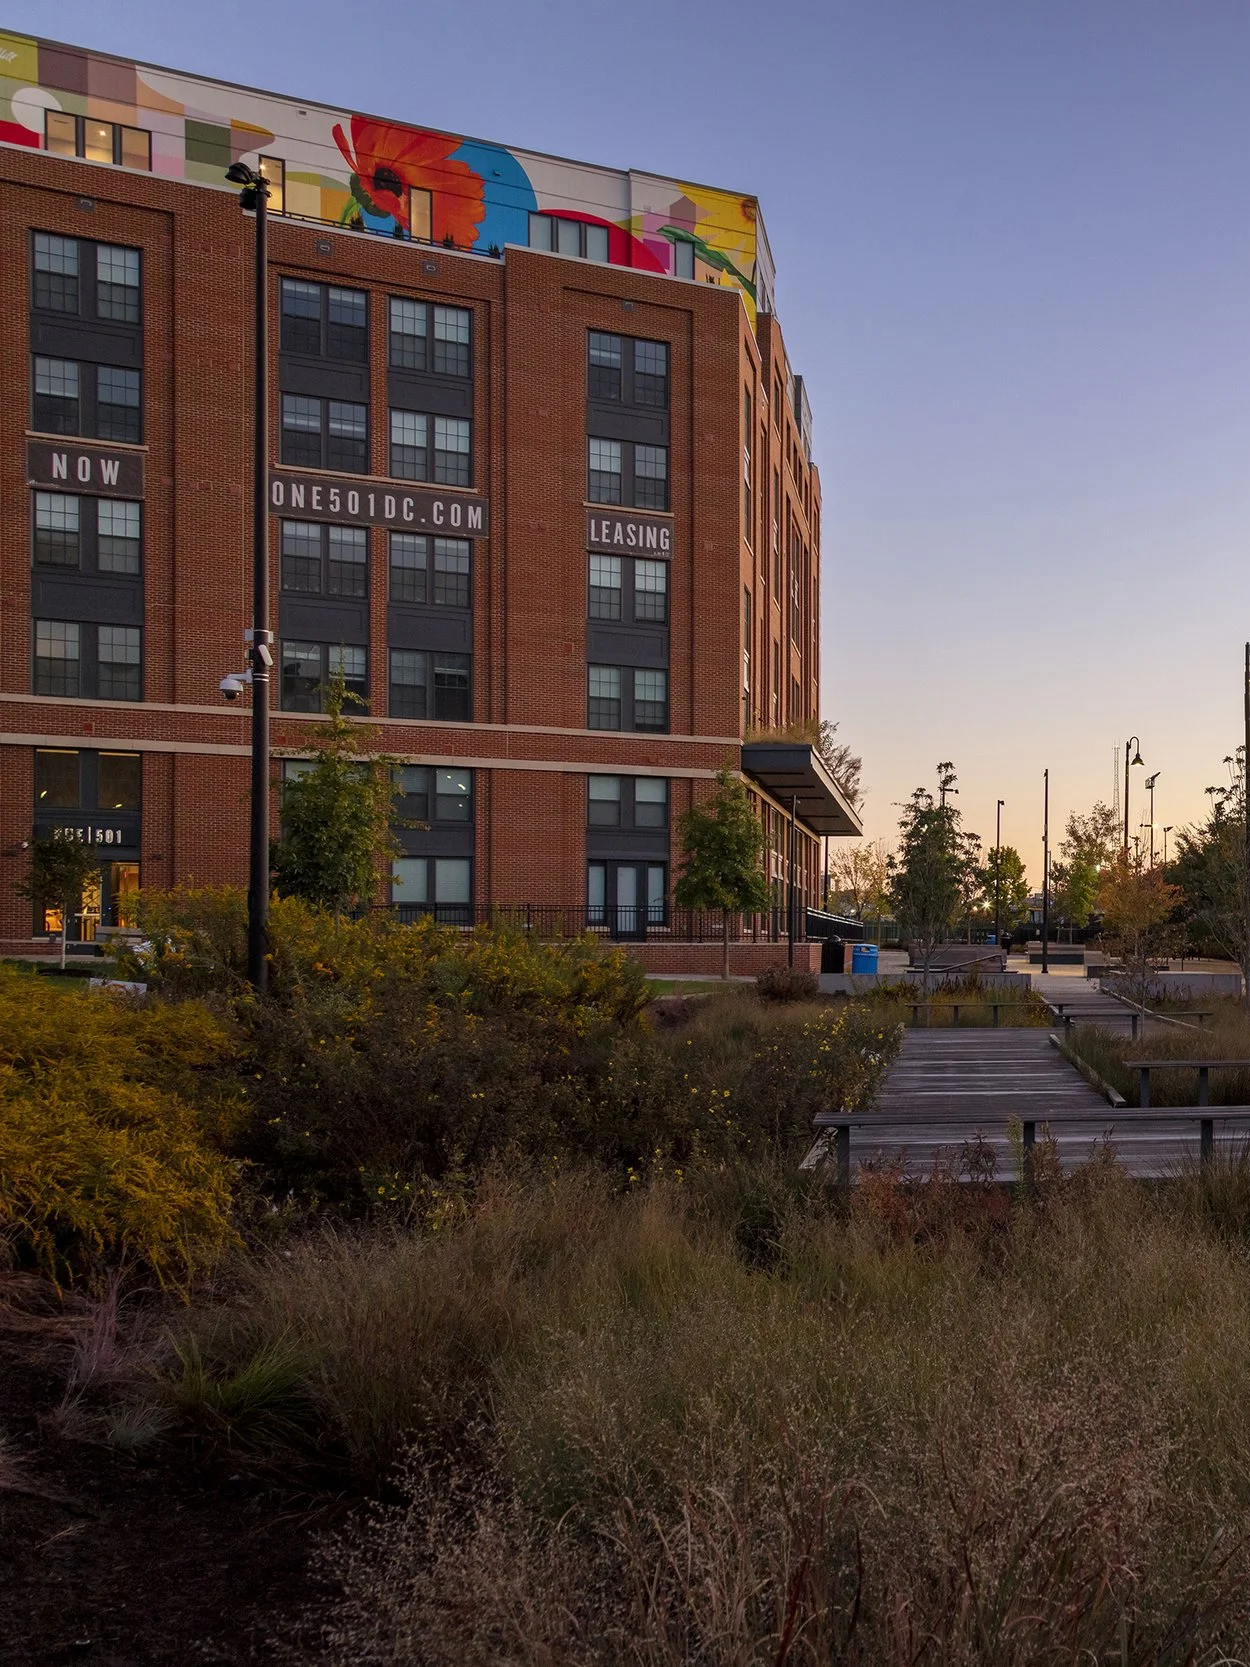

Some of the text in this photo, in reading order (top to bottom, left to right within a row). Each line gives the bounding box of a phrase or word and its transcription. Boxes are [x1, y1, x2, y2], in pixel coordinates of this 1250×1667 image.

[52, 452, 120, 486] NOW
[271, 480, 482, 530] ONE501DC.COM
[590, 518, 670, 551] LEASING
[95, 828, 122, 845] 501
